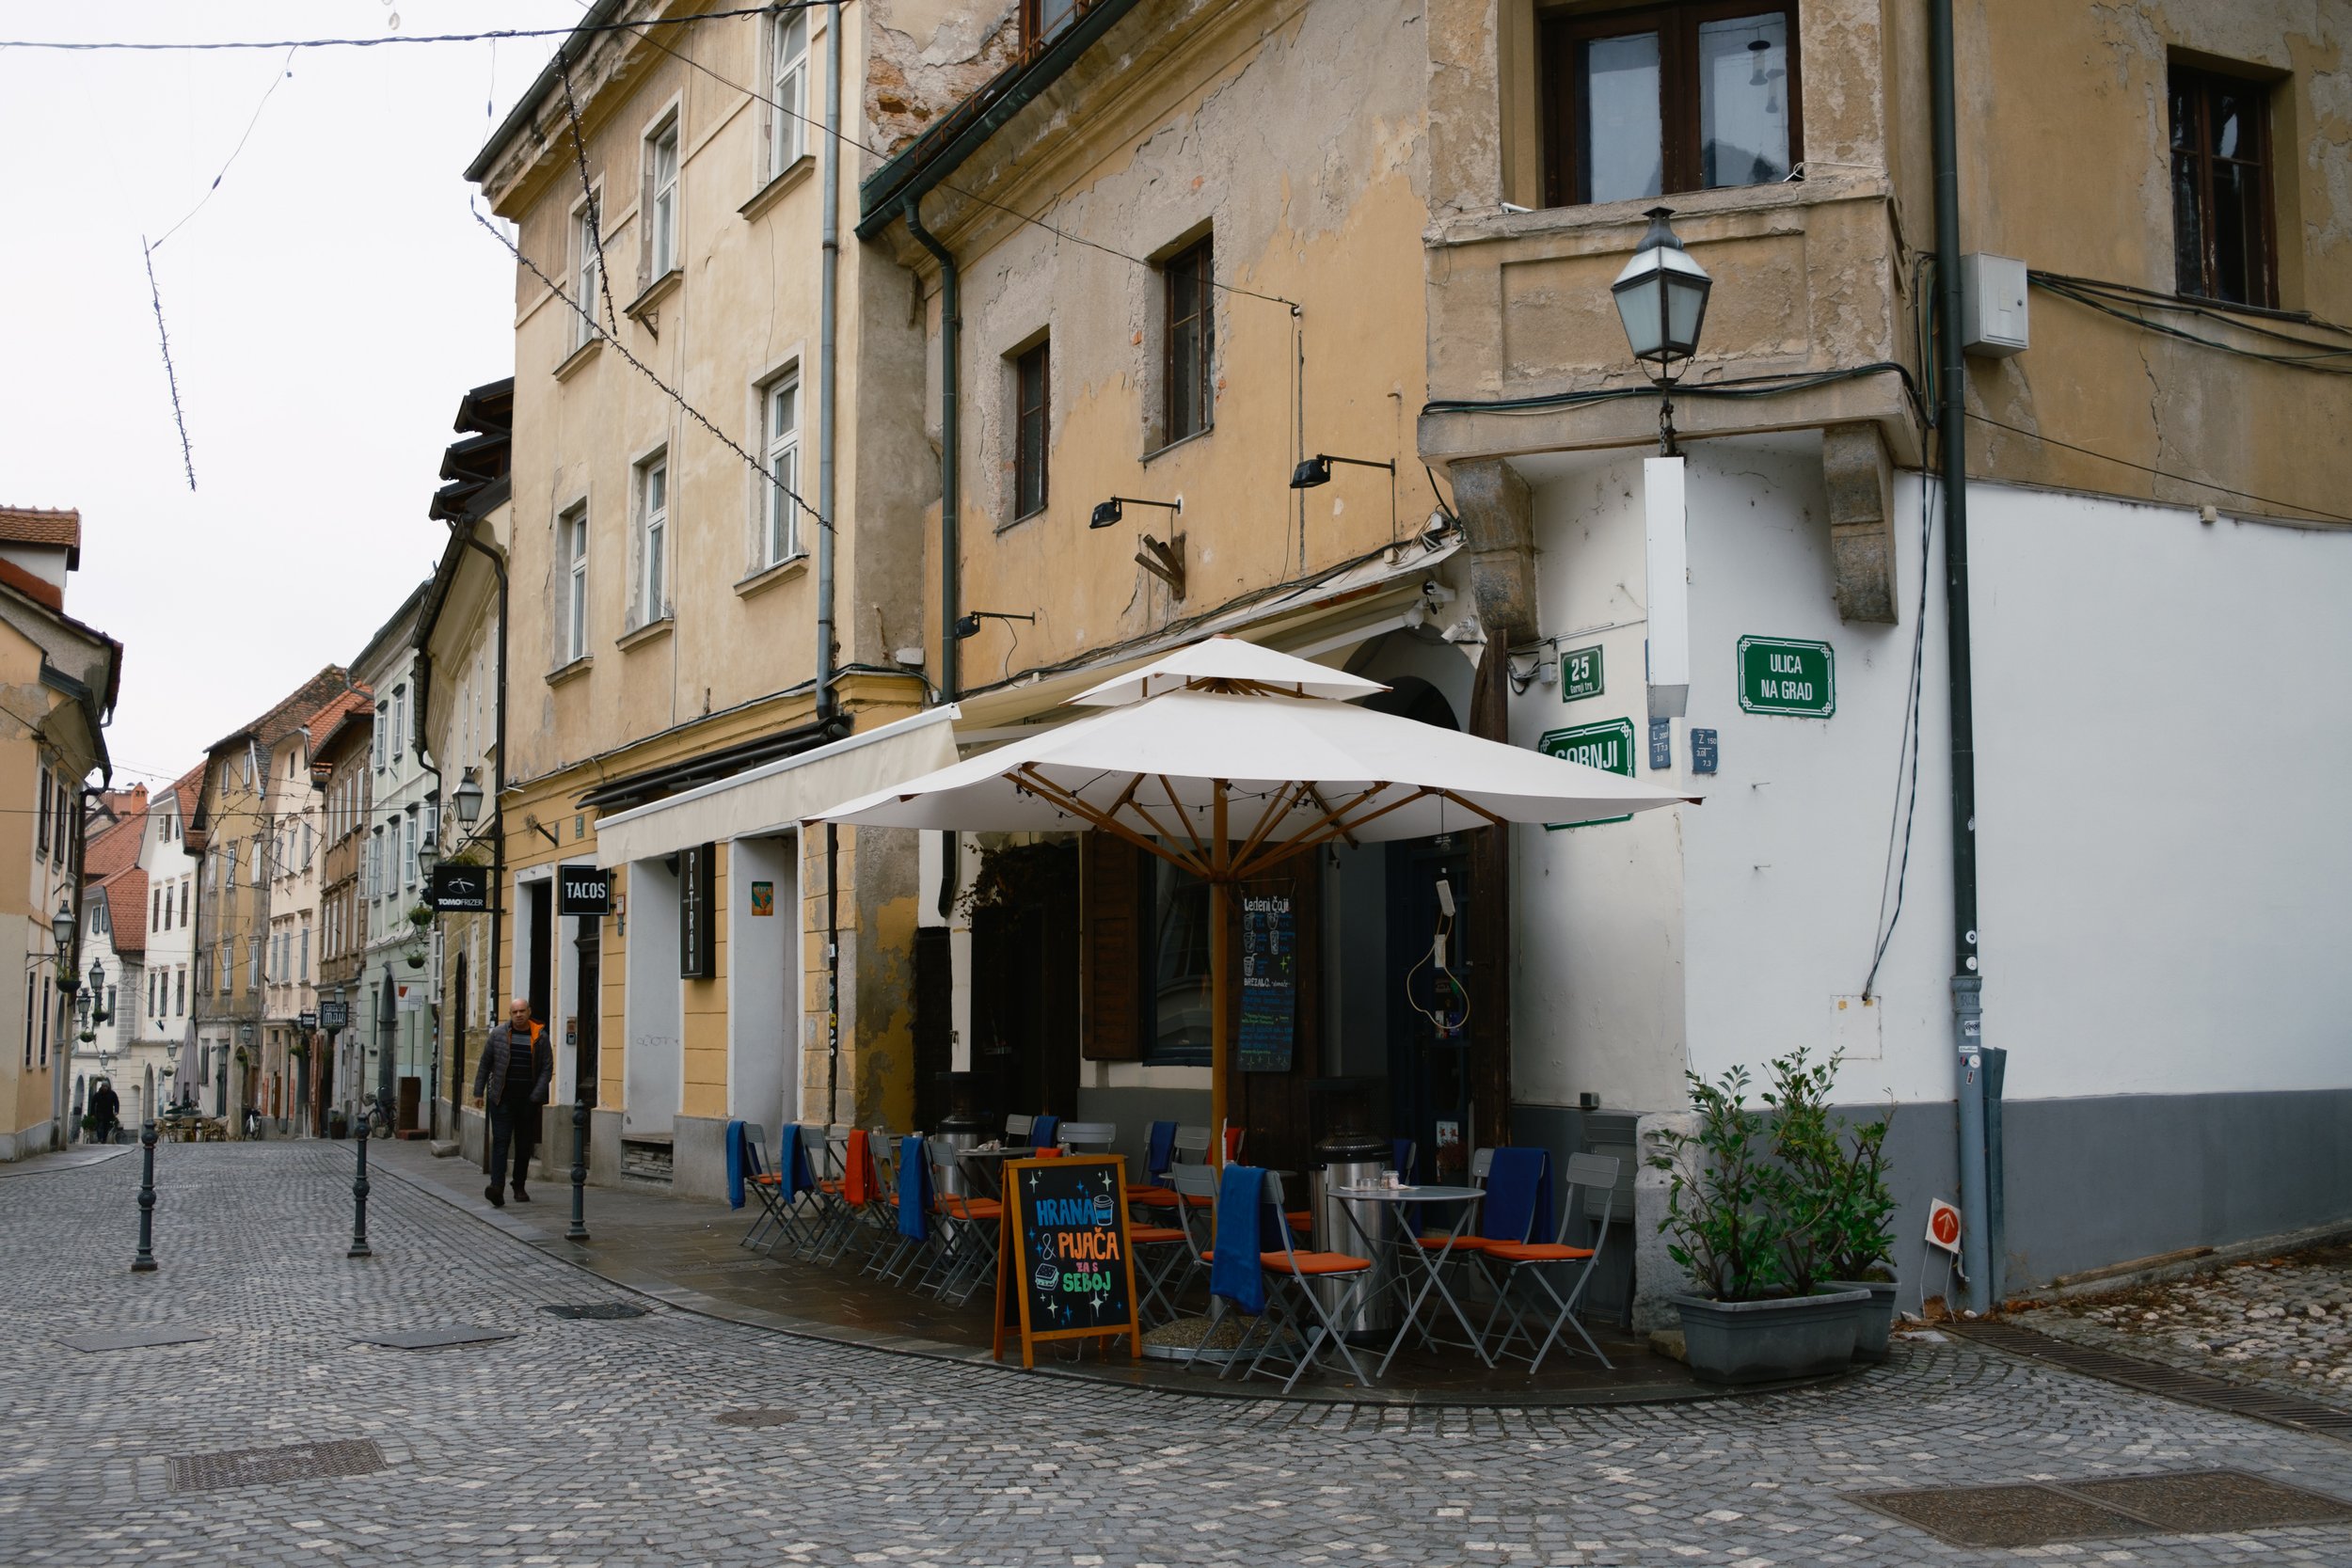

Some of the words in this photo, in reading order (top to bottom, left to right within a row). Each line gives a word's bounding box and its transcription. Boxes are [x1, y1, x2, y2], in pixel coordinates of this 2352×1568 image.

[1571, 656, 1590, 682] 25
[1770, 653, 1803, 674] ULICA
[1761, 679, 1778, 699] NA
[1781, 680, 1813, 701] GRAD
[1698, 734, 1705, 744] Z
[565, 881, 606, 899] TACOS
[1037, 1198, 1096, 1226] HRANA
[1041, 1232, 1057, 1260] &
[1057, 1227, 1120, 1260] PIJAČA
[1076, 1261, 1090, 1272] ZA
[1092, 1262, 1099, 1272] S
[1062, 1271, 1111, 1292] SEBOJ
